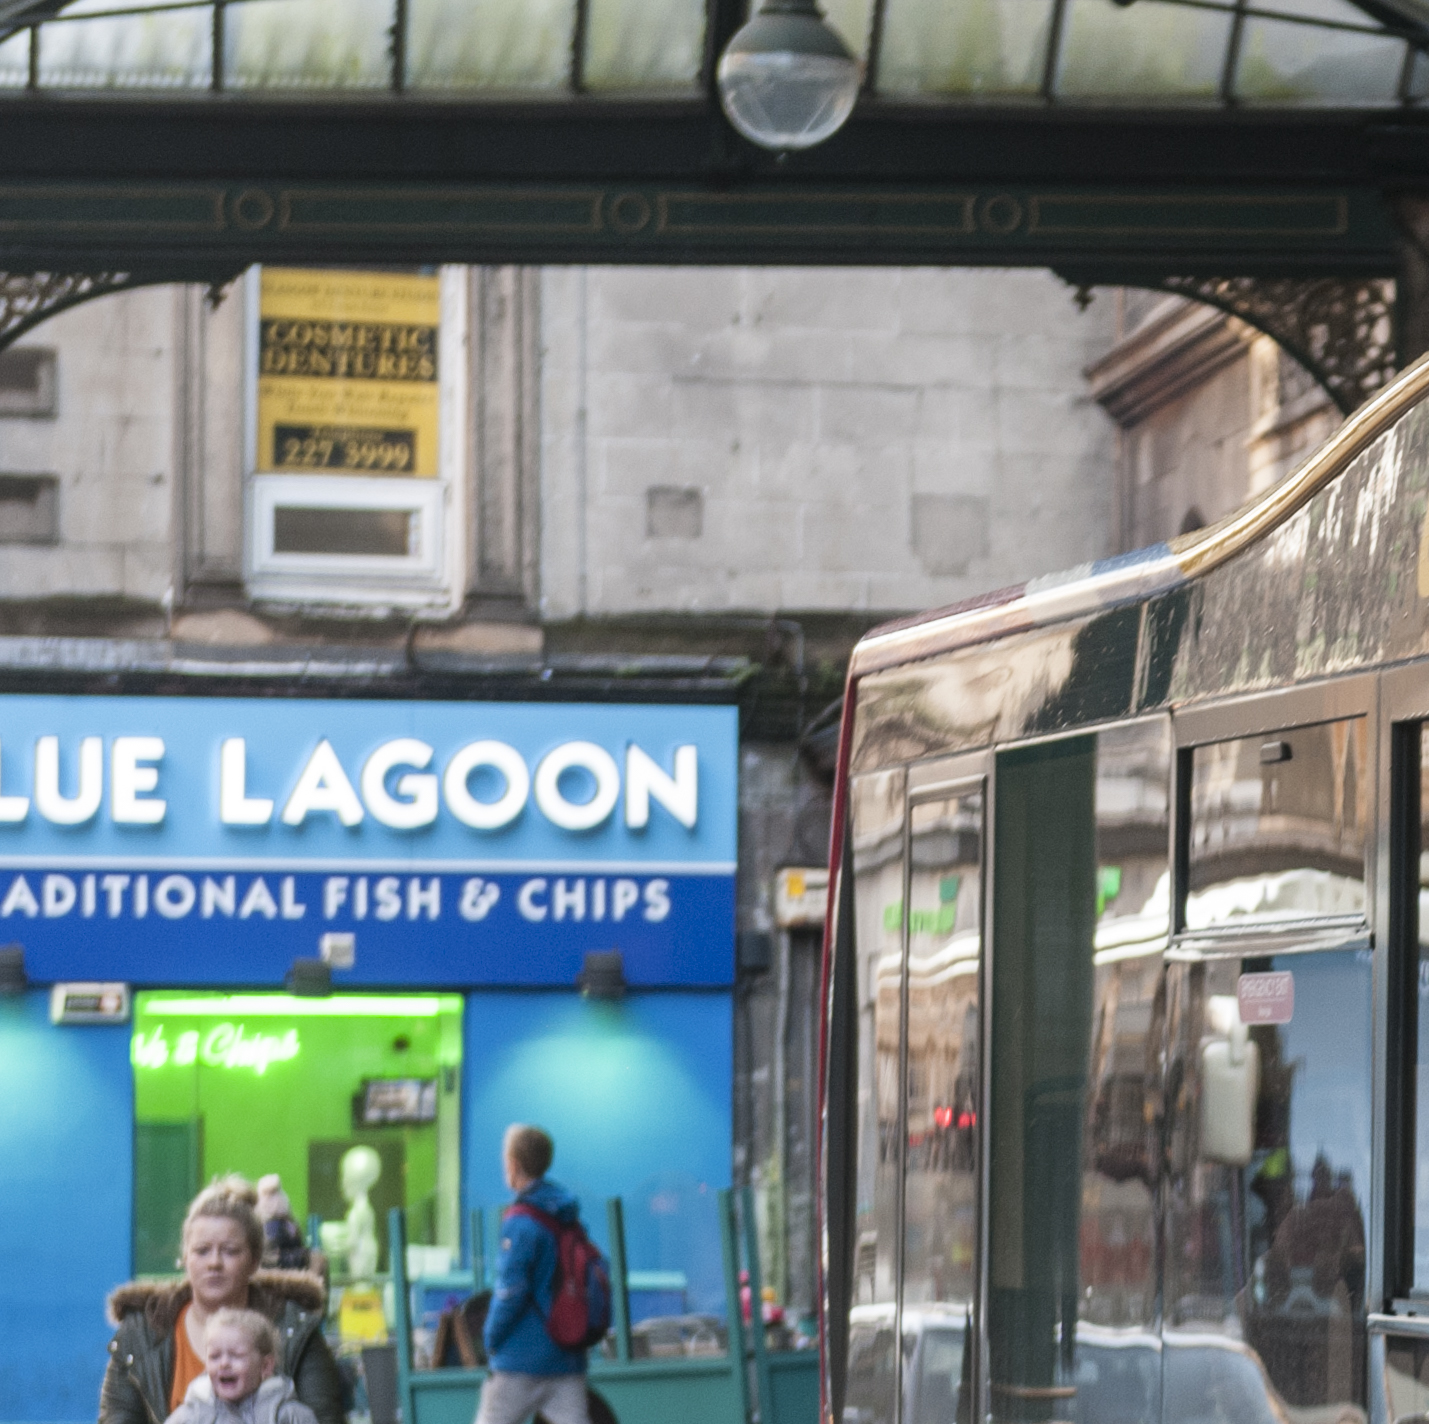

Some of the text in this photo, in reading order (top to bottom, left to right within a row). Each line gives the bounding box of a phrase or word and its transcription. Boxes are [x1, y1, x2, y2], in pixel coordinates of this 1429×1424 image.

[266, 325, 431, 350] COSMETIC
[262, 350, 435, 378] DENTURES
[283, 437, 334, 466] 227
[219, 735, 698, 830] LAGOON
[324, 875, 441, 920] FISH
[459, 876, 500, 921] &
[517, 878, 671, 922] CHIPS
